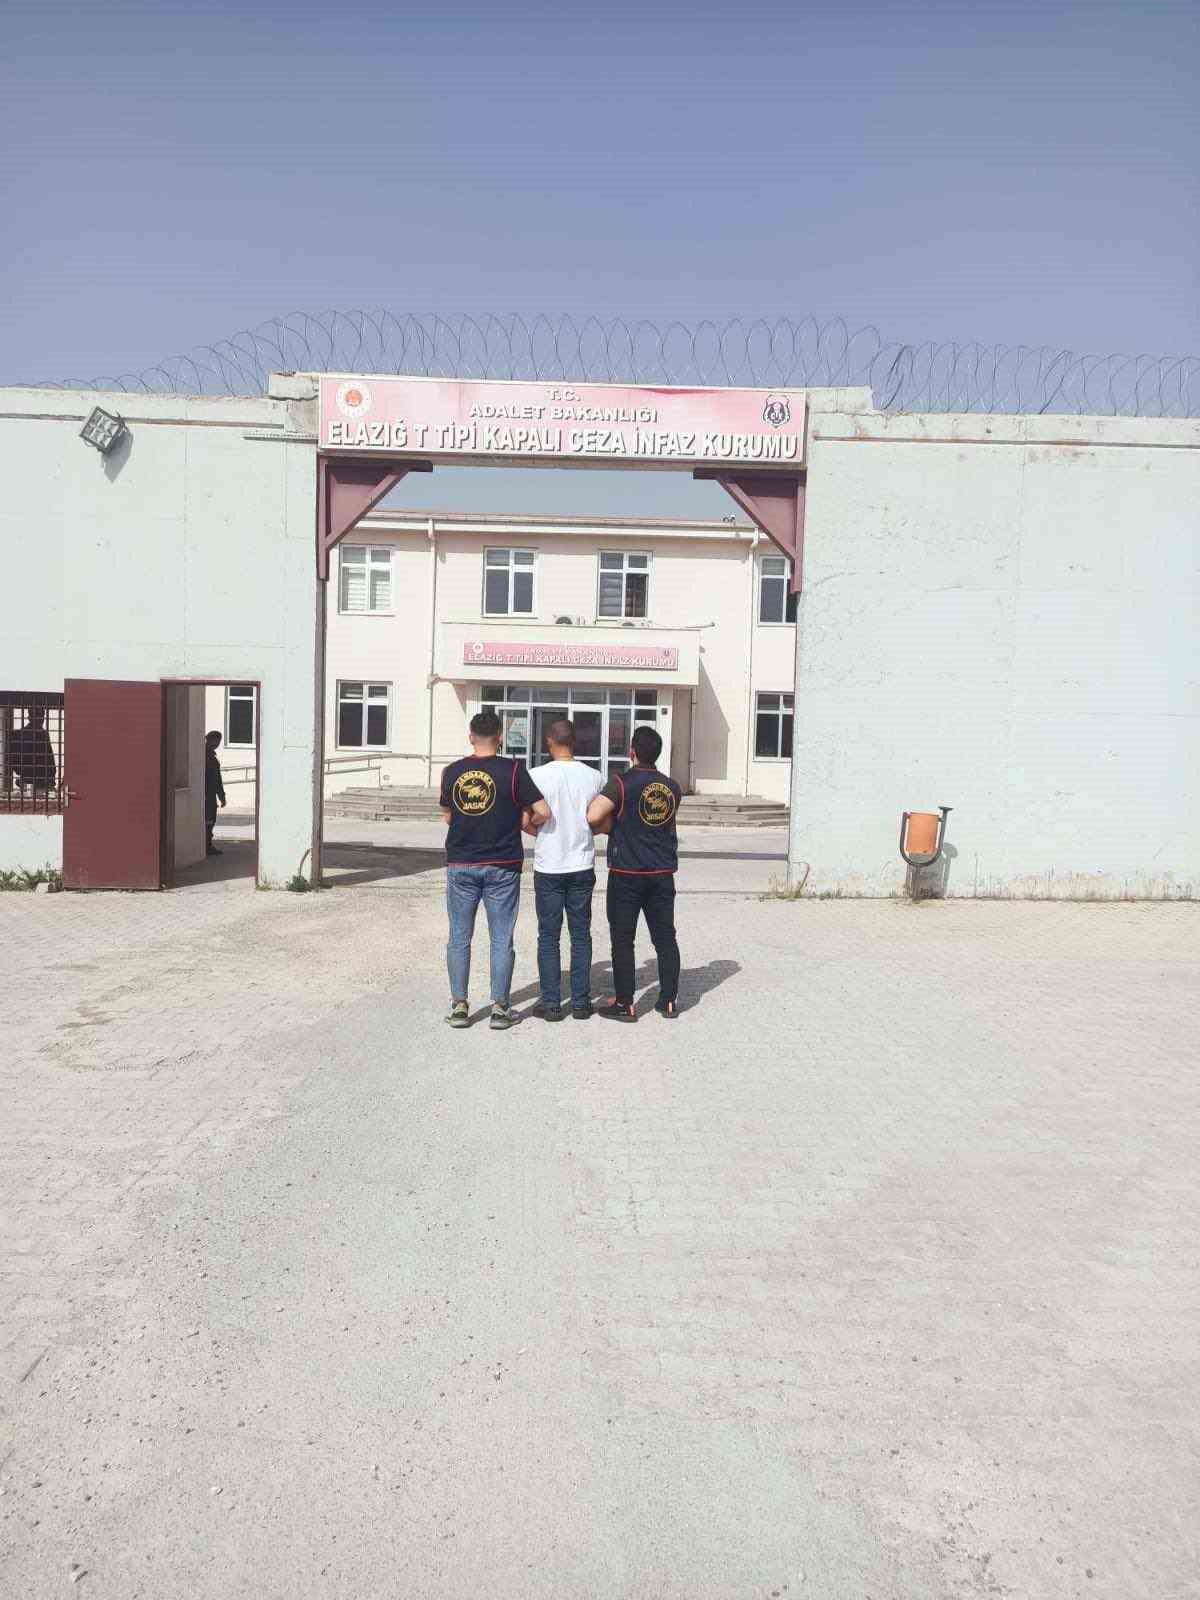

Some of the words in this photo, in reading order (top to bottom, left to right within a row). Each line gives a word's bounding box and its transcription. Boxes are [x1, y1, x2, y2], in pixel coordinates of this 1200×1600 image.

[546, 388, 582, 402] T.C.
[469, 404, 545, 419] ADALET
[551, 405, 658, 423] BAKANLIĞI
[412, 423, 429, 448] T
[433, 421, 478, 449] TİPİ
[484, 425, 562, 452] KAPALI
[569, 428, 626, 454] CEZA
[633, 426, 696, 456] İNFAZ
[703, 431, 798, 459] KURUMU
